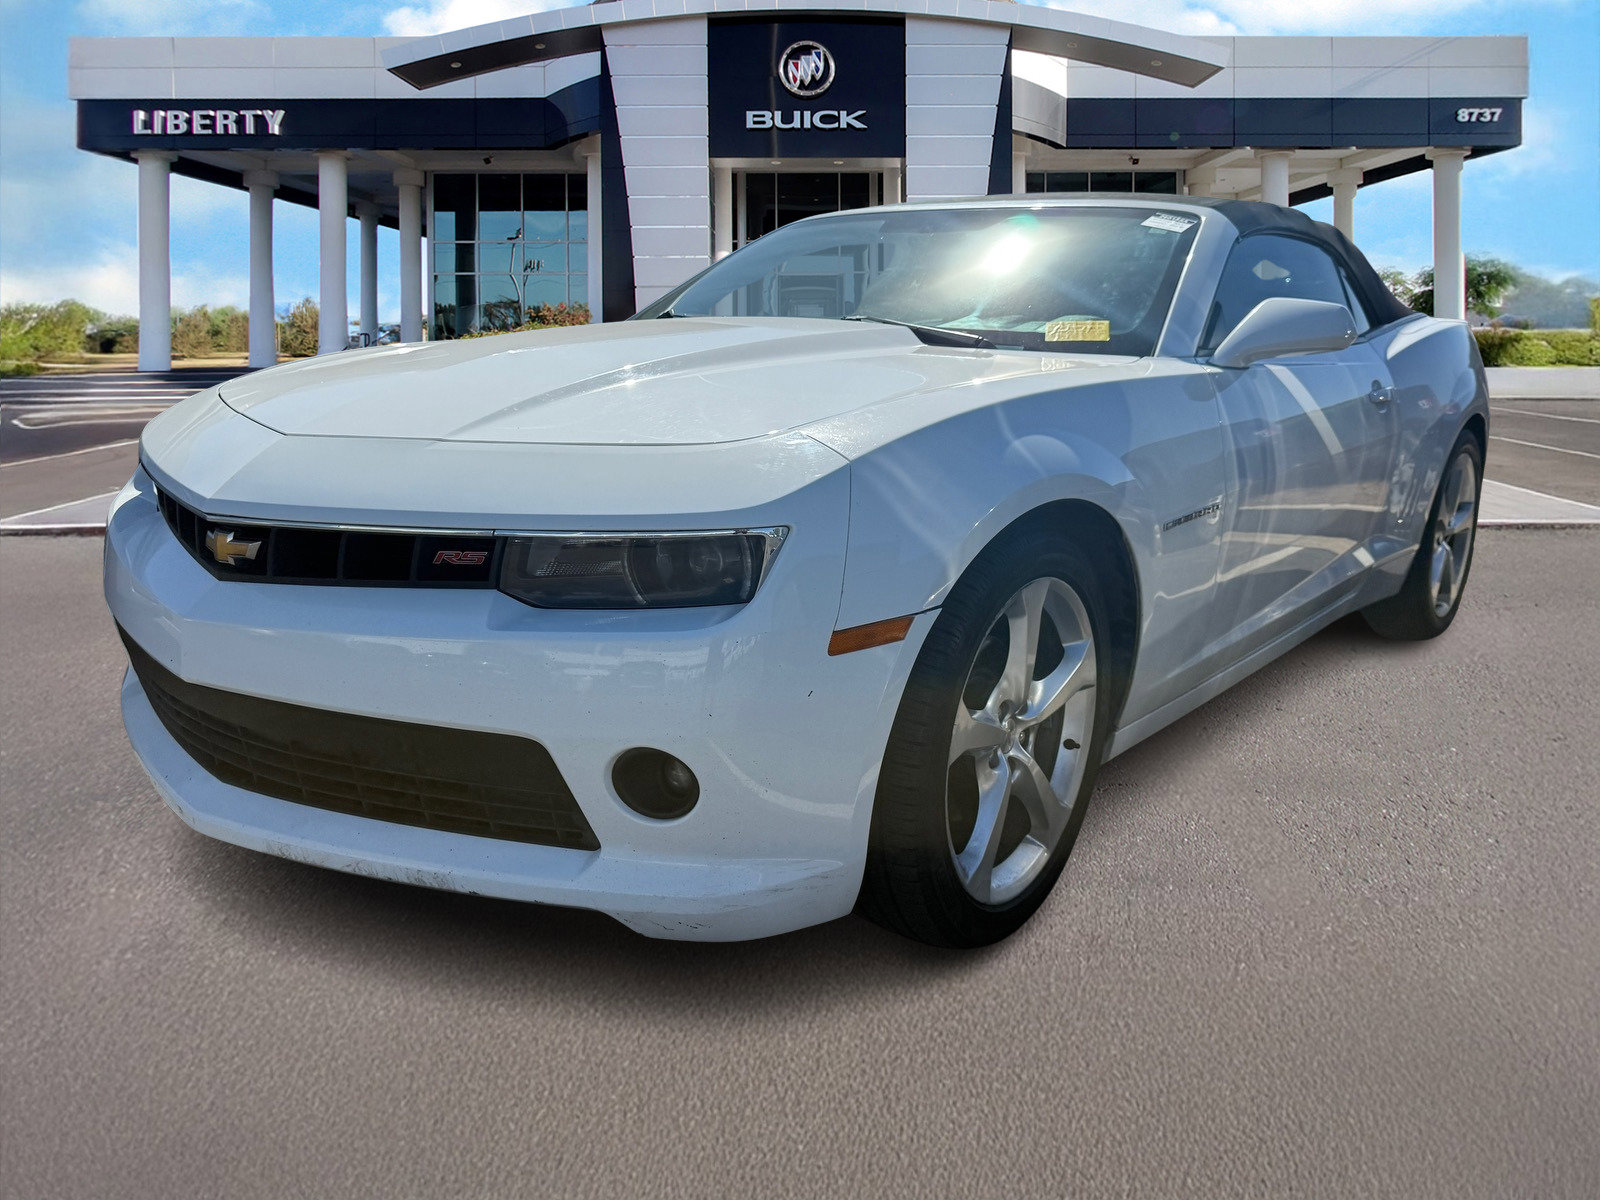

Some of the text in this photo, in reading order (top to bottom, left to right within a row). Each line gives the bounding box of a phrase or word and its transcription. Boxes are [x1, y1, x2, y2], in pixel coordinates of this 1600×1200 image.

[132, 109, 285, 135] LIBERTY
[746, 110, 868, 129] BUICK
[1456, 107, 1502, 122] 8737
[433, 551, 488, 565] RS
